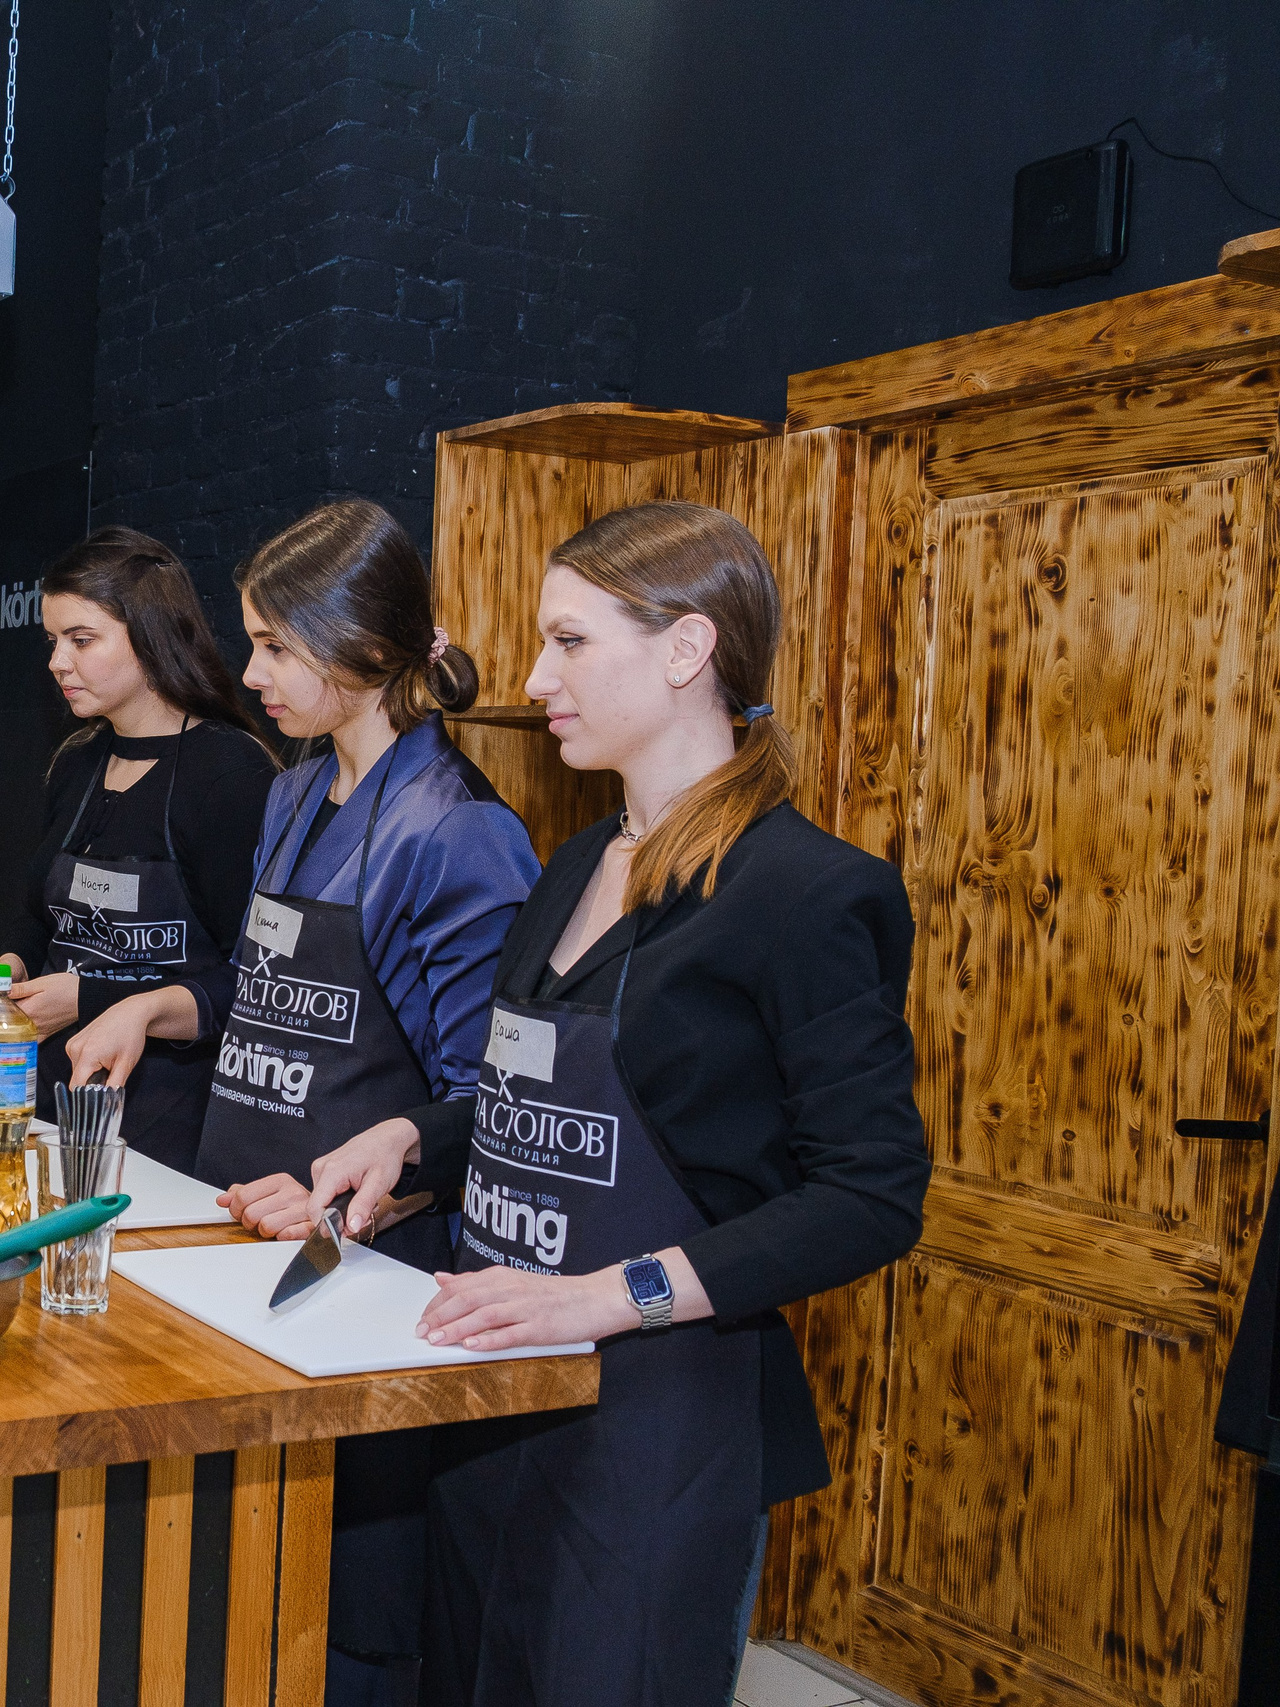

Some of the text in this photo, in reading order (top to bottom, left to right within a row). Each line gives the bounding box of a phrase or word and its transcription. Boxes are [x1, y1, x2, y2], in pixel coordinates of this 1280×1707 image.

[0, 579, 42, 629] kört
[81, 873, 110, 894] Настя
[92, 922, 179, 950] СТОЛОВ
[114, 949, 151, 960] СТУДИЯ
[250, 978, 348, 1021] СТОЛОВ
[266, 1012, 309, 1027] СТУДИЯ
[495, 1019, 520, 1042] Саша
[263, 1044, 309, 1061] since 1889
[215, 1032, 314, 1104] körting
[257, 1099, 305, 1118] техника
[491, 1102, 605, 1157] СТОЛОВ
[511, 1145, 559, 1165] СТУДИЯ
[508, 1187, 560, 1208] since 1889
[464, 1164, 567, 1265] körting
